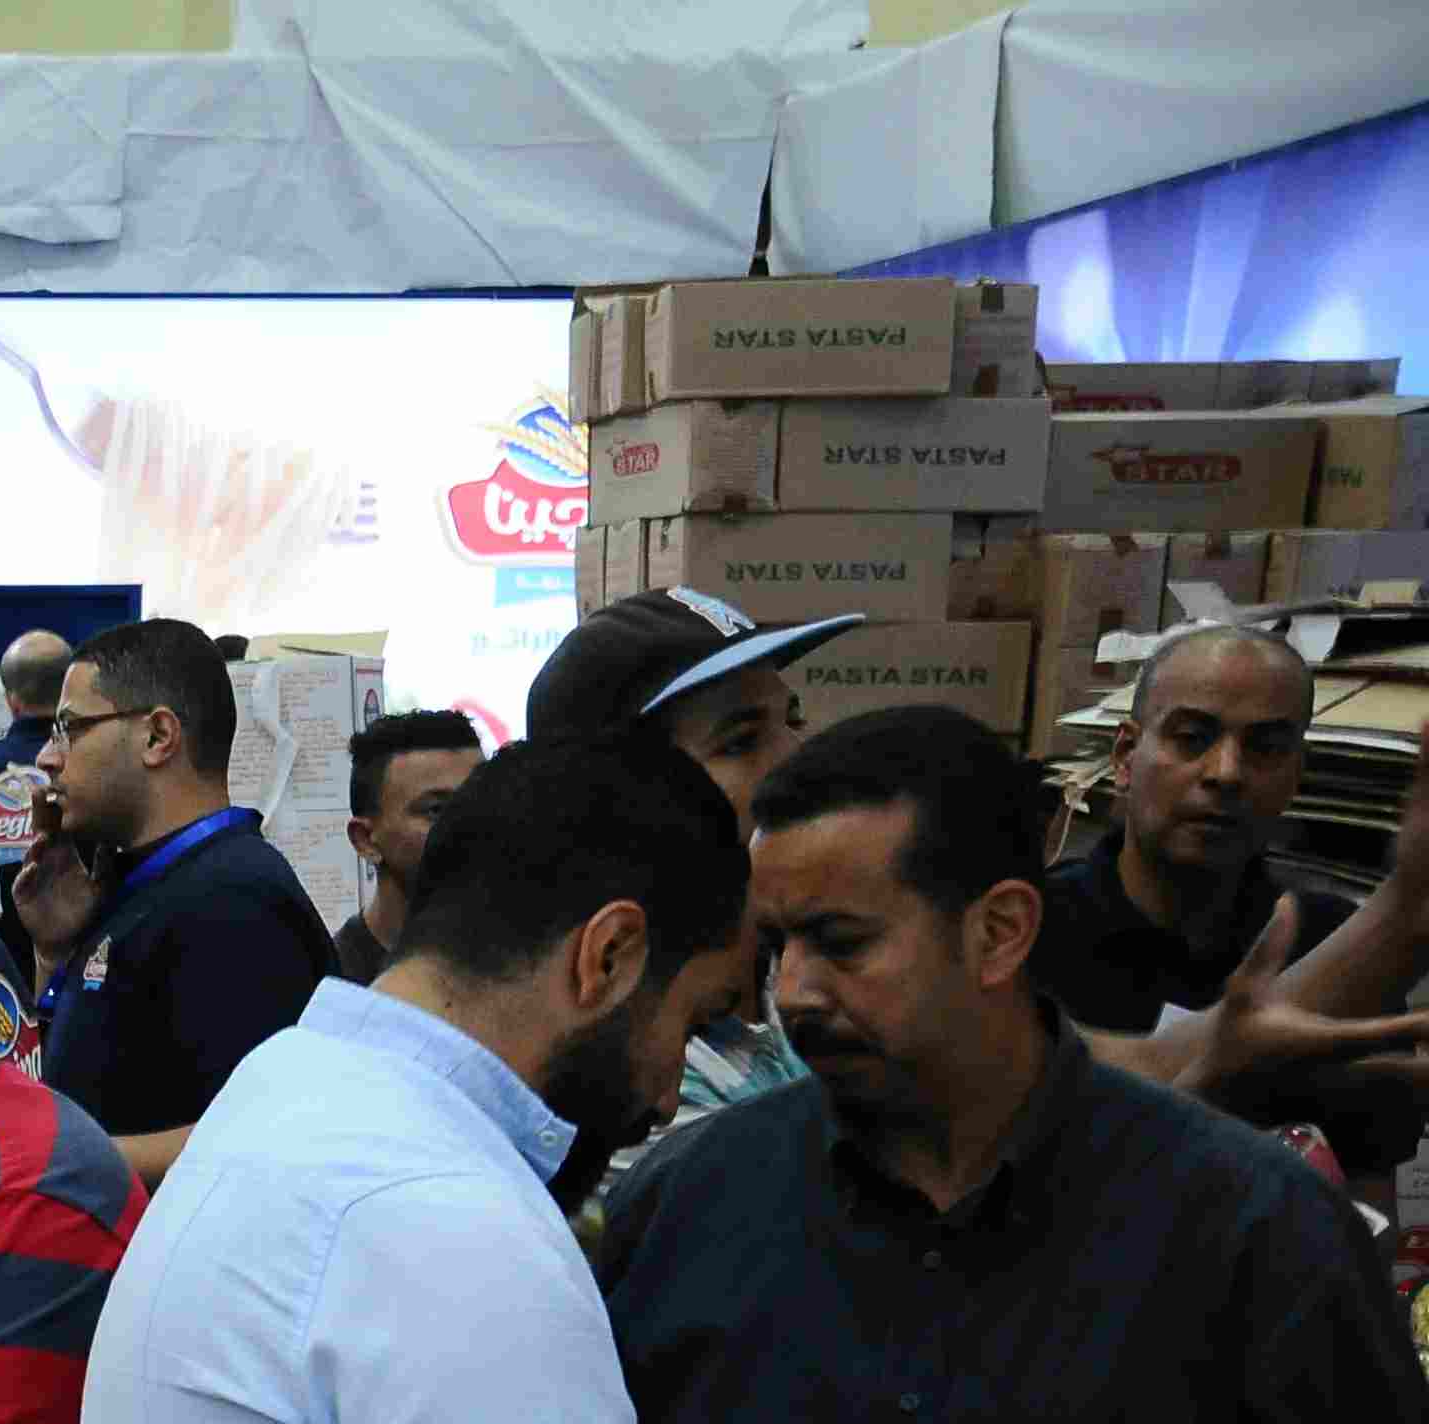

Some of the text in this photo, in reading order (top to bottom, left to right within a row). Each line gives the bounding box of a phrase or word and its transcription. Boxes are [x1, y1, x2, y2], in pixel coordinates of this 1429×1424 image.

[714, 326, 907, 349] PASTA STAR
[616, 454, 659, 475] STAR
[823, 446, 1006, 466] PASTA STAR
[725, 562, 907, 581] PASTA STAR
[806, 667, 990, 686] PASTA STAR
